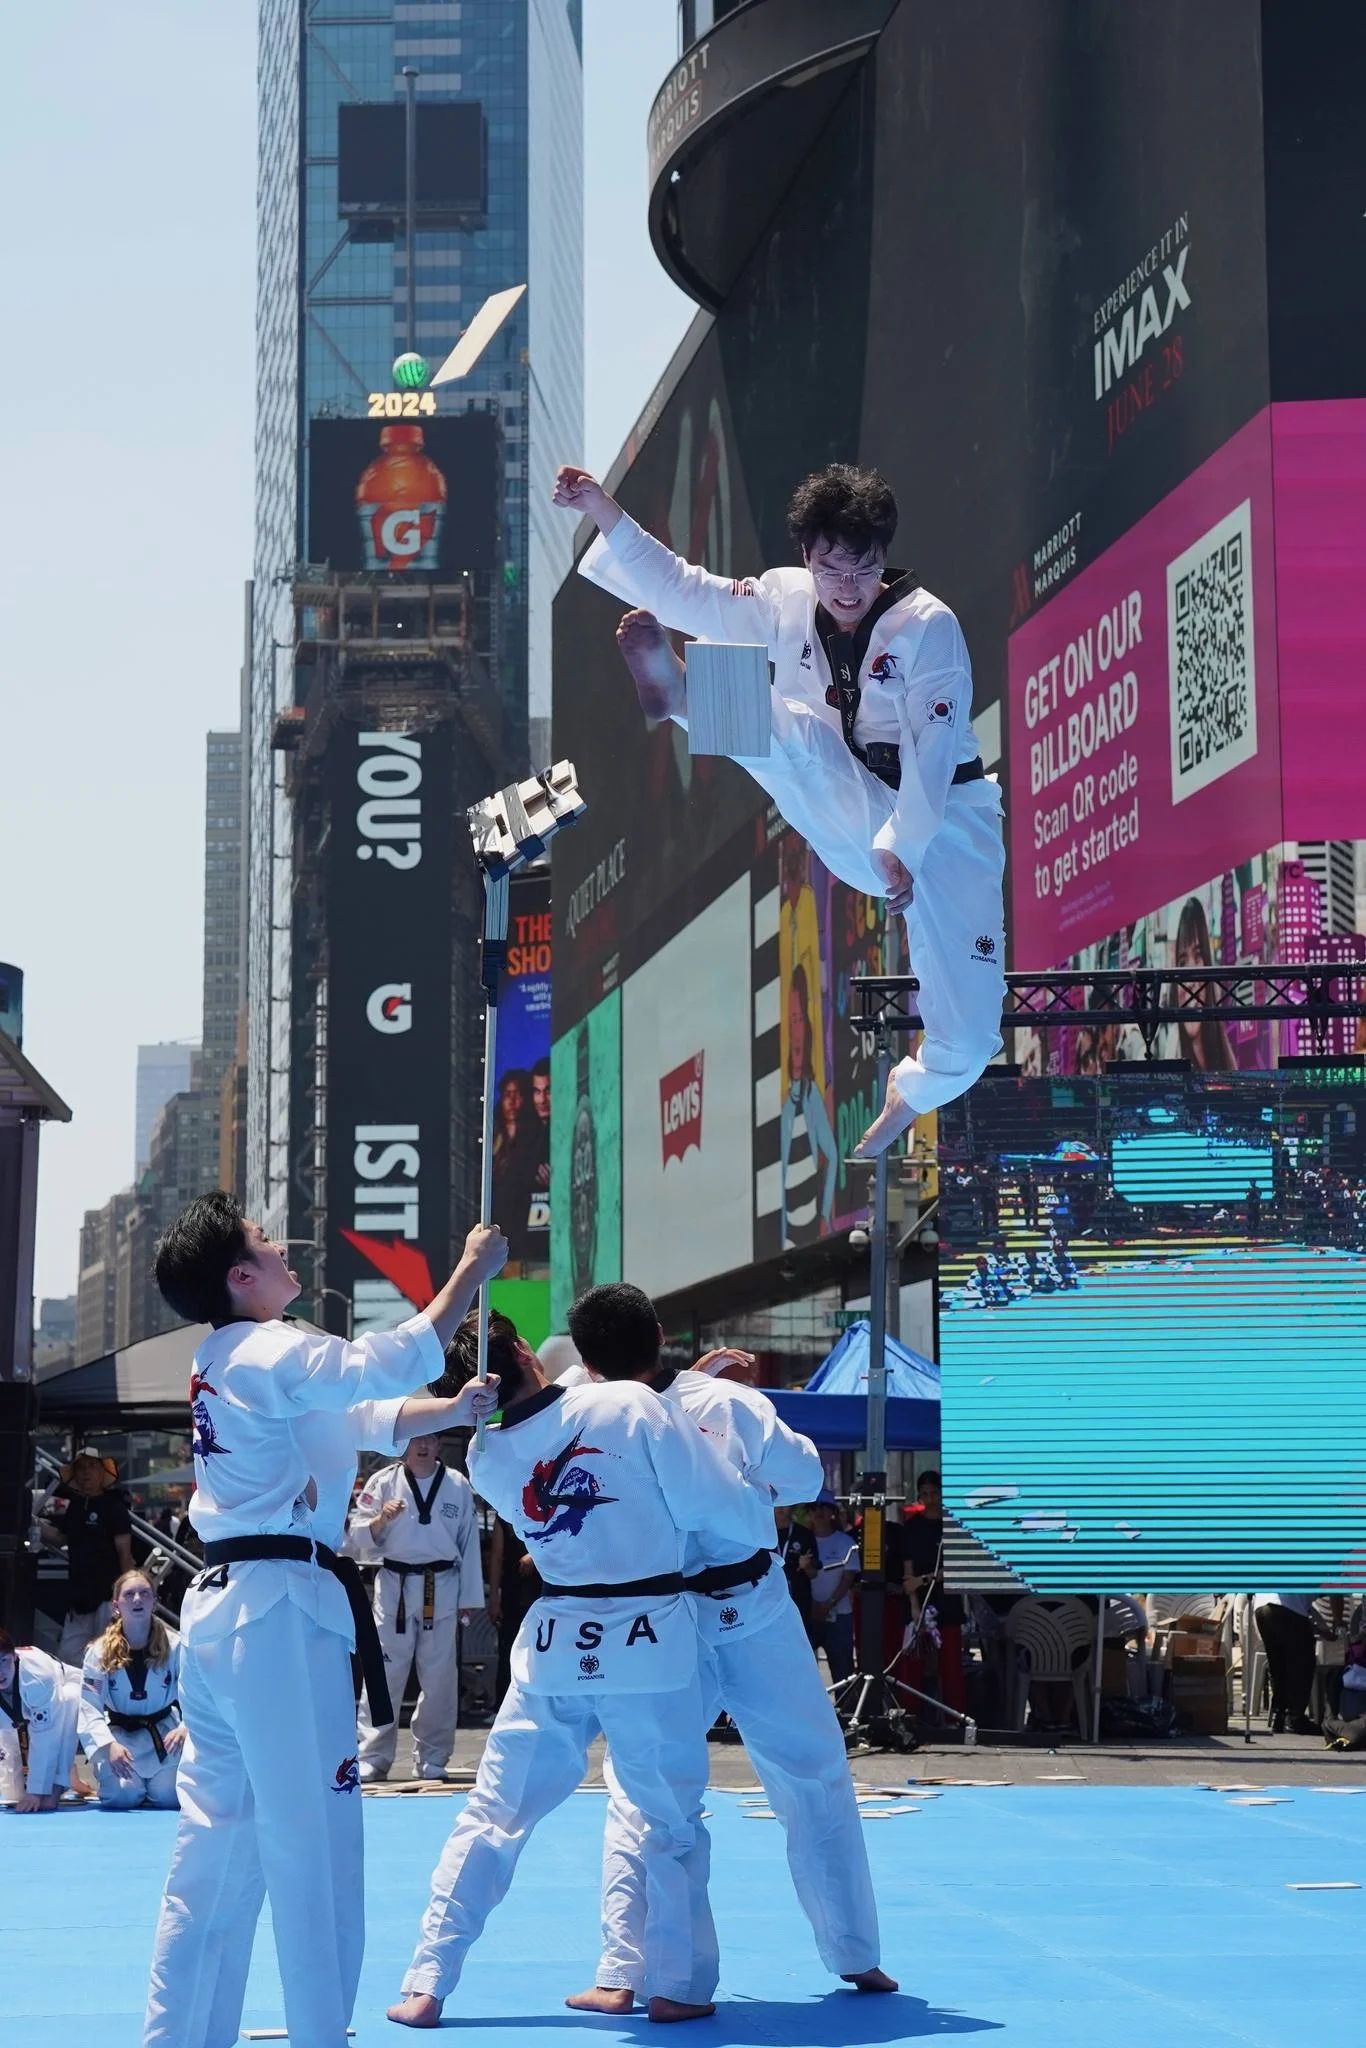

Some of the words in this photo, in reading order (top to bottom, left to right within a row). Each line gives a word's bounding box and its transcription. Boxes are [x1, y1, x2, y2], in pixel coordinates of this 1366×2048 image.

[1094, 245, 1159, 335] EXPERIENCE
[1160, 228, 1174, 261] IT
[1175, 210, 1189, 244] IN
[1094, 244, 1192, 402] IMAX
[368, 391, 437, 417] 2024
[1106, 362, 1155, 457] JUNE
[1162, 335, 1184, 391] 28
[381, 509, 421, 556] G
[1033, 510, 1083, 572] MARRIOTT
[1033, 545, 1077, 600] MARQUIS
[1025, 654, 1061, 730] GET
[1063, 627, 1094, 699] ON
[1097, 589, 1143, 672] OUR
[1030, 670, 1139, 796] BILLBOARD
[356, 731, 423, 870] YOU?
[1034, 801, 1069, 850] Scan
[1072, 773, 1095, 823] QR
[1099, 749, 1138, 806] code
[1034, 862, 1051, 899] to
[1053, 839, 1078, 897] get
[1081, 796, 1139, 871] started
[596, 837, 626, 903] PLACE
[514, 913, 552, 945] THE
[366, 983, 413, 1035] G
